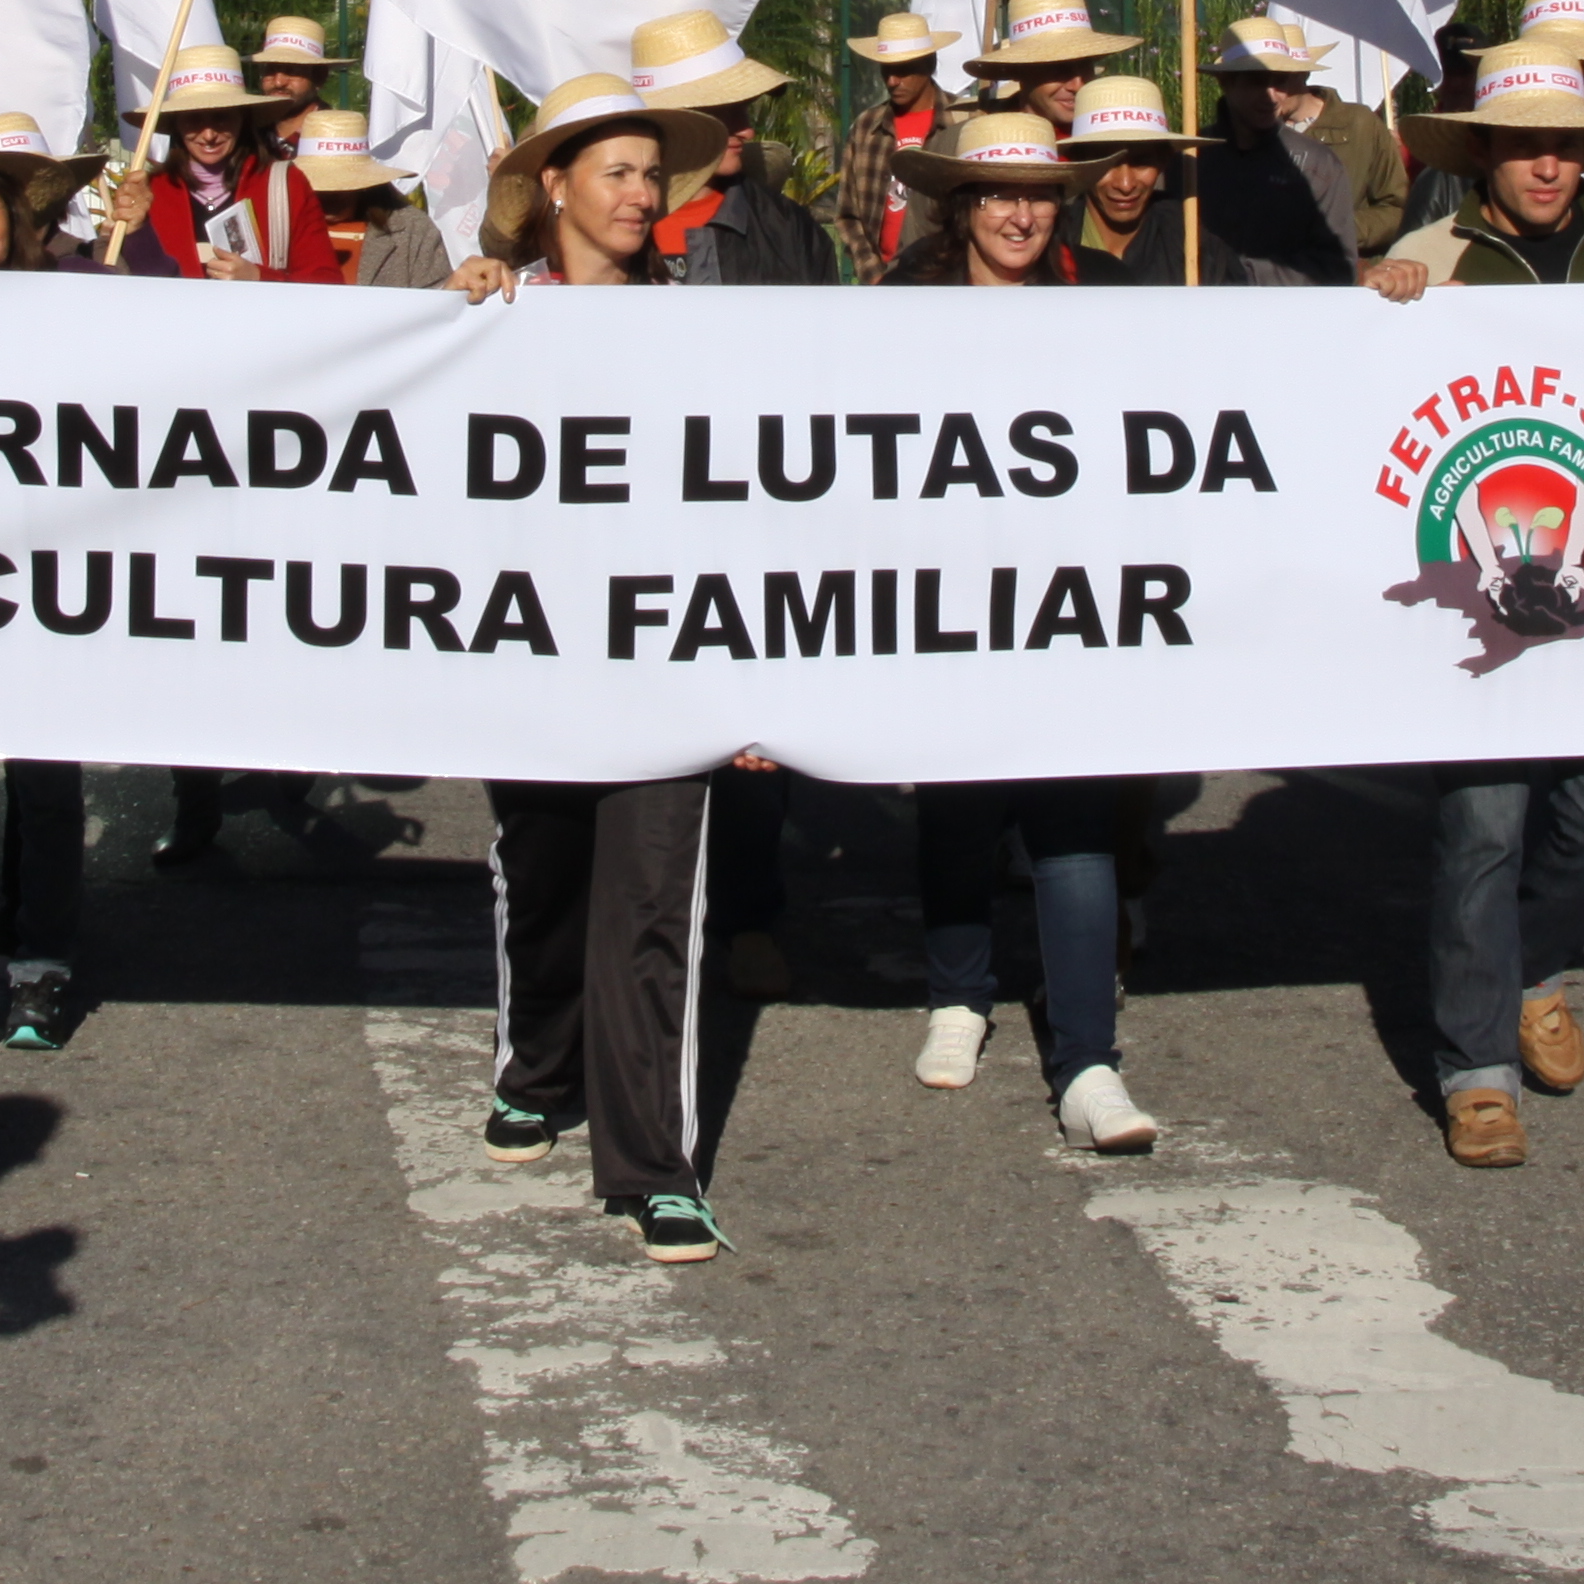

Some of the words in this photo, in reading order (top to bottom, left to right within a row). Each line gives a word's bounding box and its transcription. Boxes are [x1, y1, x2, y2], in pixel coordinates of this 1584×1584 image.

[1522, 1, 1584, 23] RAF-SUL
[1474, 72, 1546, 100] RAF-SUL
[1552, 74, 1580, 90] CUT
[466, 411, 632, 505] DE
[681, 409, 1080, 503] LUTAS
[1122, 409, 1279, 495] DA
[1429, 429, 1545, 521] AGRICULTURA
[606, 562, 1195, 662] FAMILIAR
